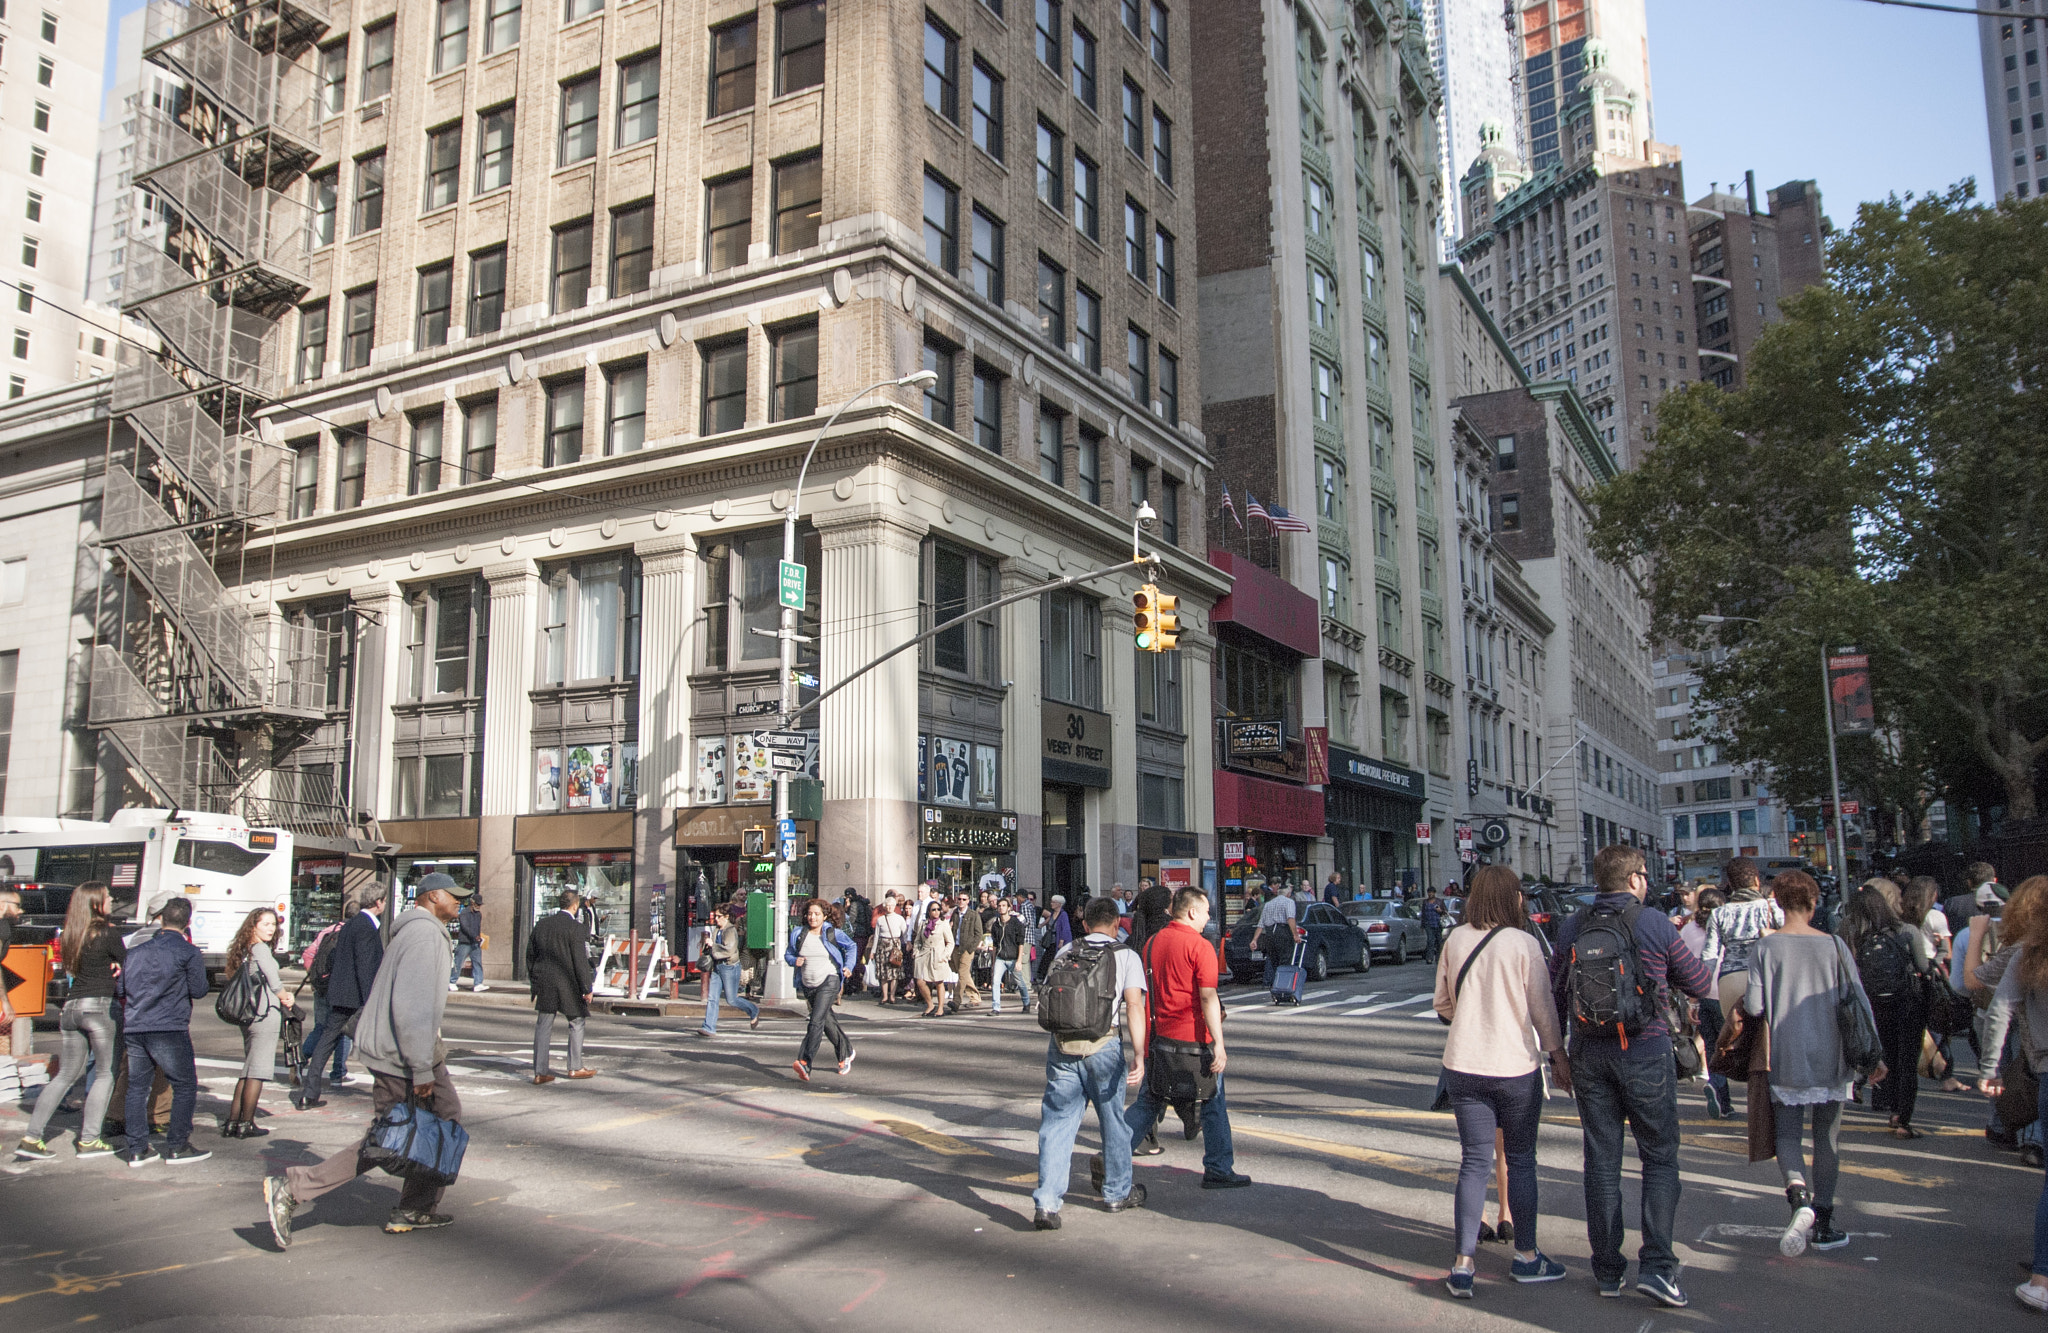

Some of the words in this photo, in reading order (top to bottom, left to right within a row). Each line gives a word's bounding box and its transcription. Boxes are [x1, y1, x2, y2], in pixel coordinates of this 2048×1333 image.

[783, 577, 802, 591] DRIVE
[739, 705, 760, 714] CHURCH
[1067, 713, 1085, 740] 30
[1233, 724, 1256, 737] STAGE
[1257, 724, 1279, 736] DOOR
[760, 735, 778, 744] ONE
[786, 737, 803, 745] WAY
[1047, 738, 1073, 755] VESEY
[1076, 744, 1103, 761] STREET
[776, 757, 787, 766] ONE
[790, 758, 801, 766] WAY
[1358, 762, 1382, 780] MEMORIAL
[1382, 769, 1401, 784] PREVIEW
[1401, 774, 1410, 788] SITE
[569, 795, 590, 807] MARVEL
[251, 834, 275, 844] LIMITED
[1224, 843, 1243, 854] ATM
[754, 862, 773, 872] ATM
